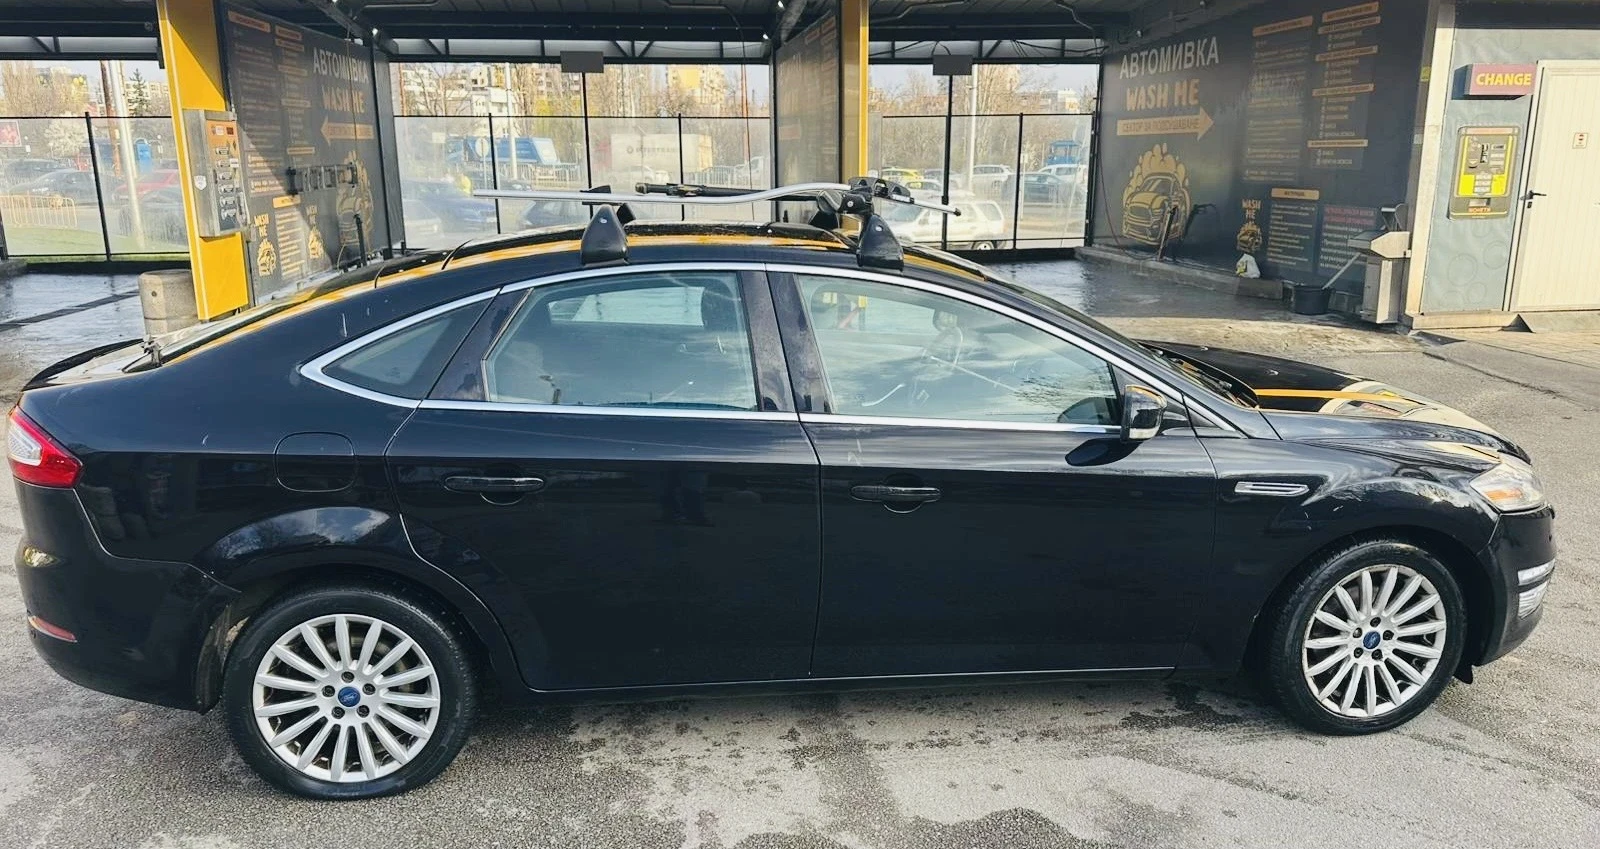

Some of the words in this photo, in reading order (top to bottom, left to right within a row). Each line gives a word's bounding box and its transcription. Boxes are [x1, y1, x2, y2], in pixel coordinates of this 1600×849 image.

[313, 47, 369, 83] АВТОМИВКА
[1120, 36, 1219, 79] АВТОМИВКА
[1476, 73, 1532, 86] CHANGE
[322, 85, 350, 112] WASH
[1126, 83, 1169, 112] WASH
[1242, 199, 1261, 210] WASH
[254, 213, 269, 227] WASH
